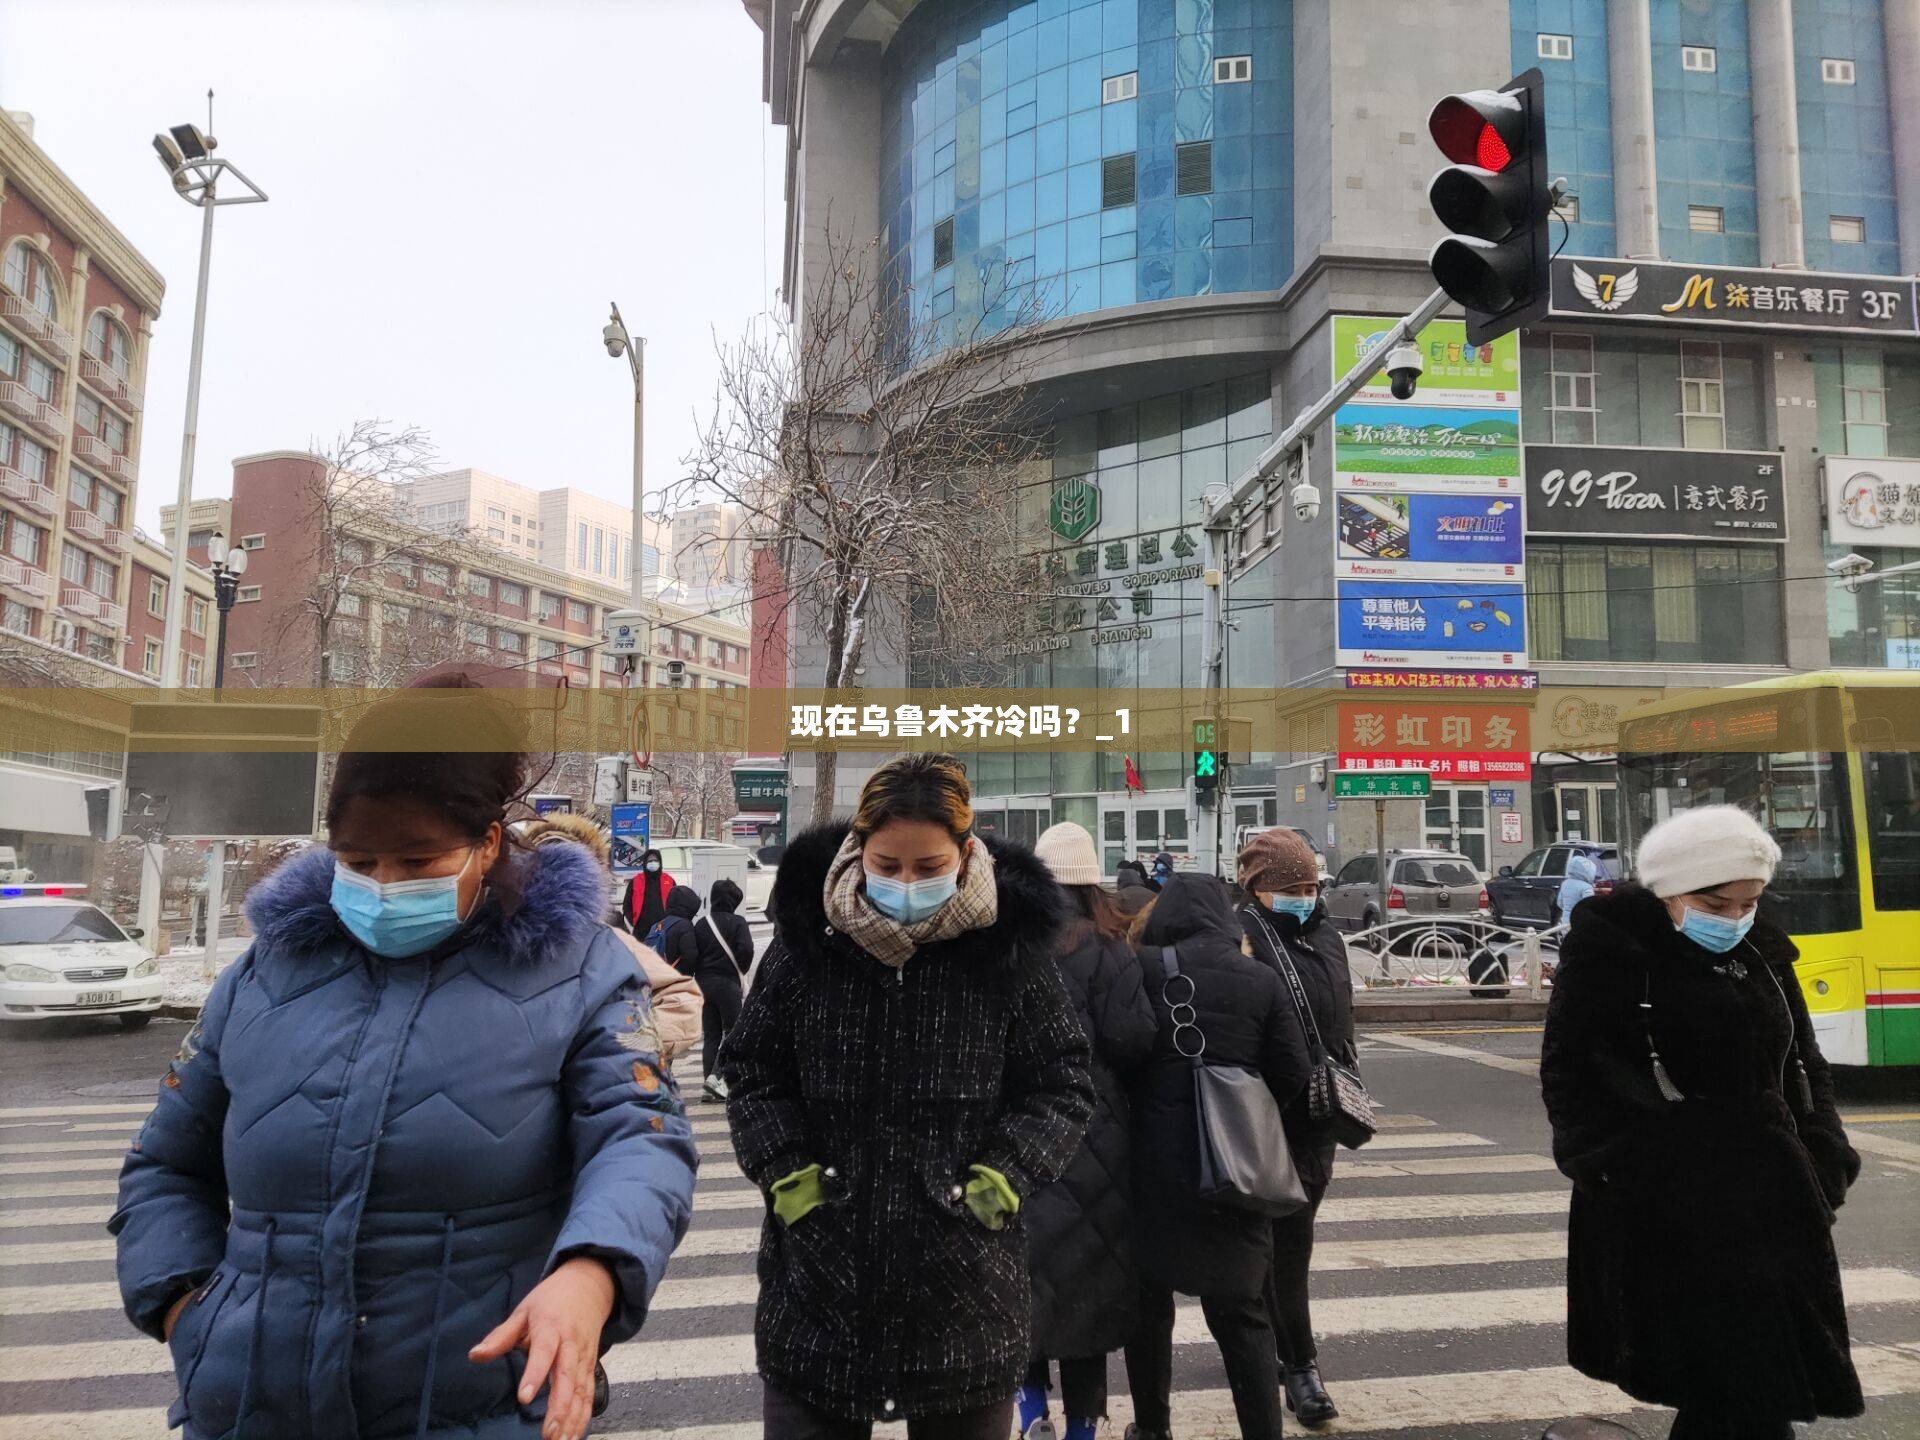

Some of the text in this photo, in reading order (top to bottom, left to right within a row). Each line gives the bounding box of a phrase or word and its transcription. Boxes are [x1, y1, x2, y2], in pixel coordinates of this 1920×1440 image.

[1726, 283, 1850, 314] 柒音乐餐厅
[1861, 290, 1901, 319] 3F
[1757, 465, 1774, 475] 2F
[1541, 468, 1594, 508] 9.9
[1684, 485, 1769, 512] 意式餐厅
[1361, 599, 1426, 614] 尊重他人
[1362, 616, 1427, 632] 平等相待
[1001, 626, 1153, 655] XINJIANG BRANCH
[1196, 724, 1215, 744] 05
[1353, 713, 1517, 749] 彩虹印务
[1429, 759, 1452, 772] 名片
[1457, 760, 1480, 773] 照相
[740, 786, 787, 797] 兰世牛肉
[1342, 781, 1422, 791] 新华北路
